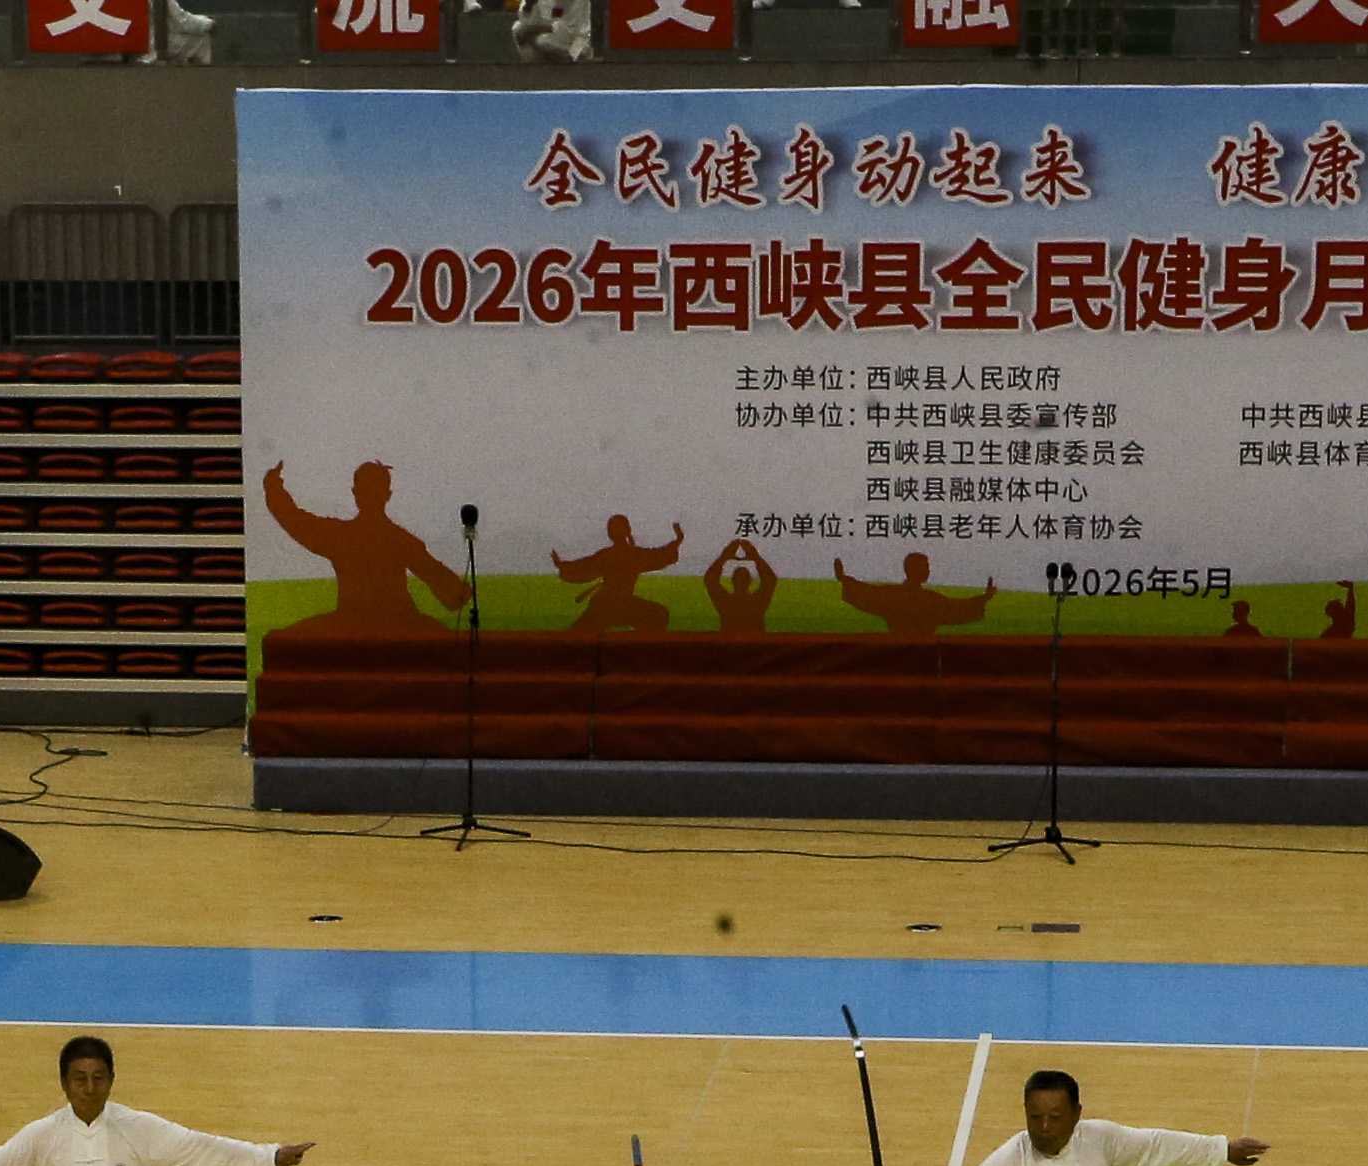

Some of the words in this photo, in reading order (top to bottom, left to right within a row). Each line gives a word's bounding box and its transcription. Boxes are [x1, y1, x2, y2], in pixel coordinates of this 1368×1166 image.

[527, 127, 1089, 209] 全民健身动起来
[866, 439, 1146, 466] 西峡县卫生健康委员会
[866, 476, 1089, 503] 西峡县融媒体中心
[1062, 565, 1232, 599] 2026年5月
